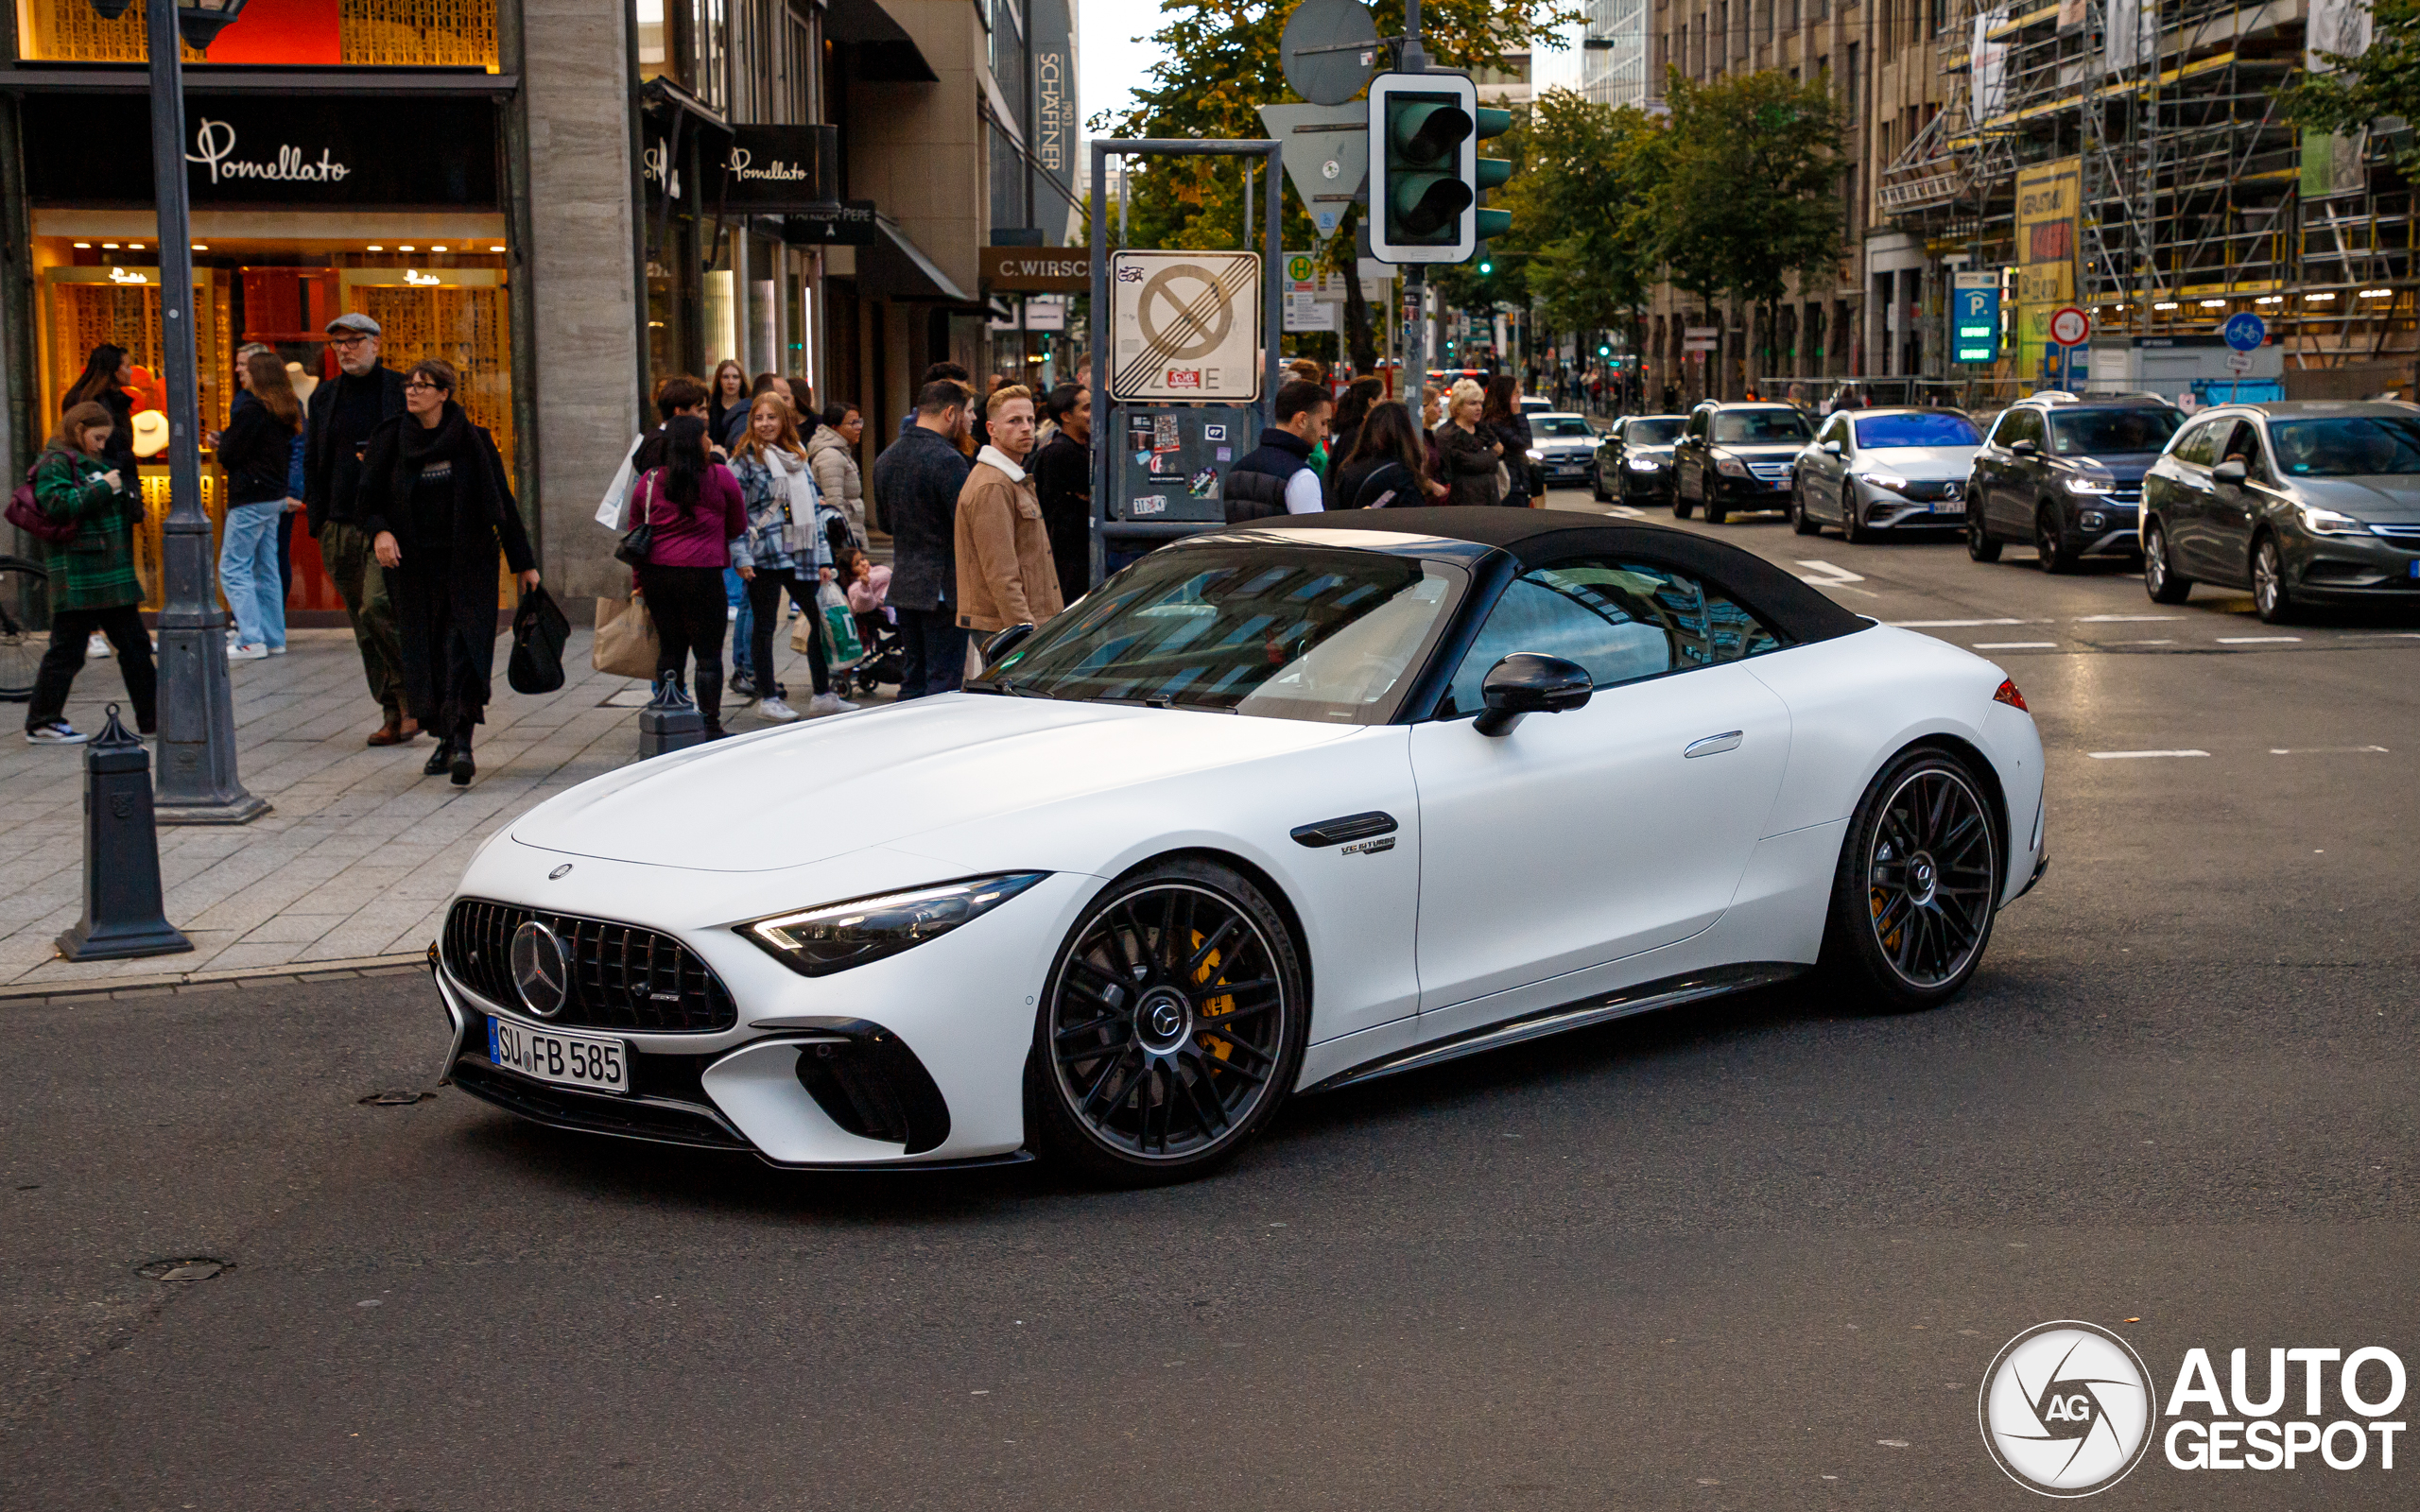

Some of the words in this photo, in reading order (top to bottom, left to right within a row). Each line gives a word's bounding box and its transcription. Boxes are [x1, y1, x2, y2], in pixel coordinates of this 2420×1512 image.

[1040, 53, 1060, 170] SCHÄFFNER
[184, 117, 351, 184] Pomellato
[721, 146, 807, 181] Pomellato
[1358, 836, 1395, 850] BITURBO
[499, 1025, 522, 1066] SU
[532, 1036, 564, 1075] FB
[570, 1041, 621, 1084] 585
